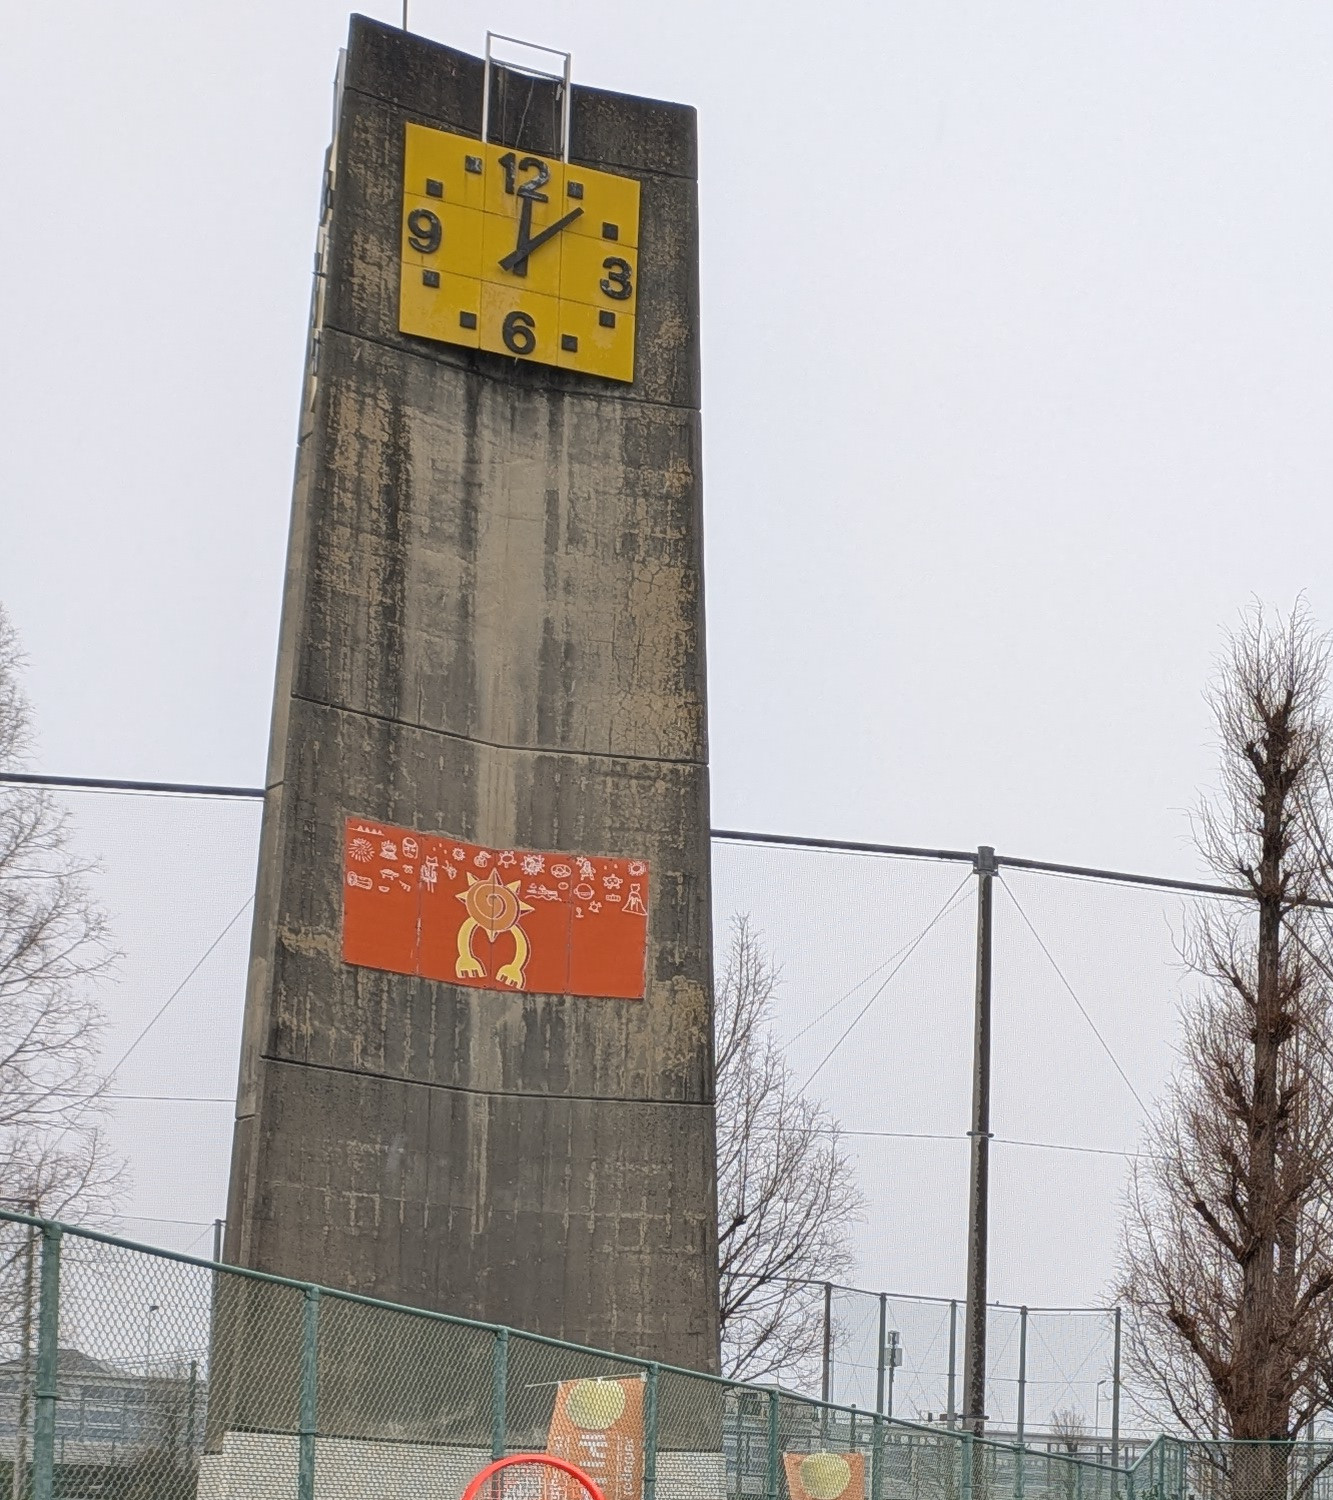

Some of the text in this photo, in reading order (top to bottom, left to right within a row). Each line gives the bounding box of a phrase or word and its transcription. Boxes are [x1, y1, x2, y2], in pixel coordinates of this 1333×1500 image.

[498, 152, 550, 202] 12
[407, 208, 442, 253] 9
[601, 258, 632, 300] 3
[502, 311, 536, 355] 6
